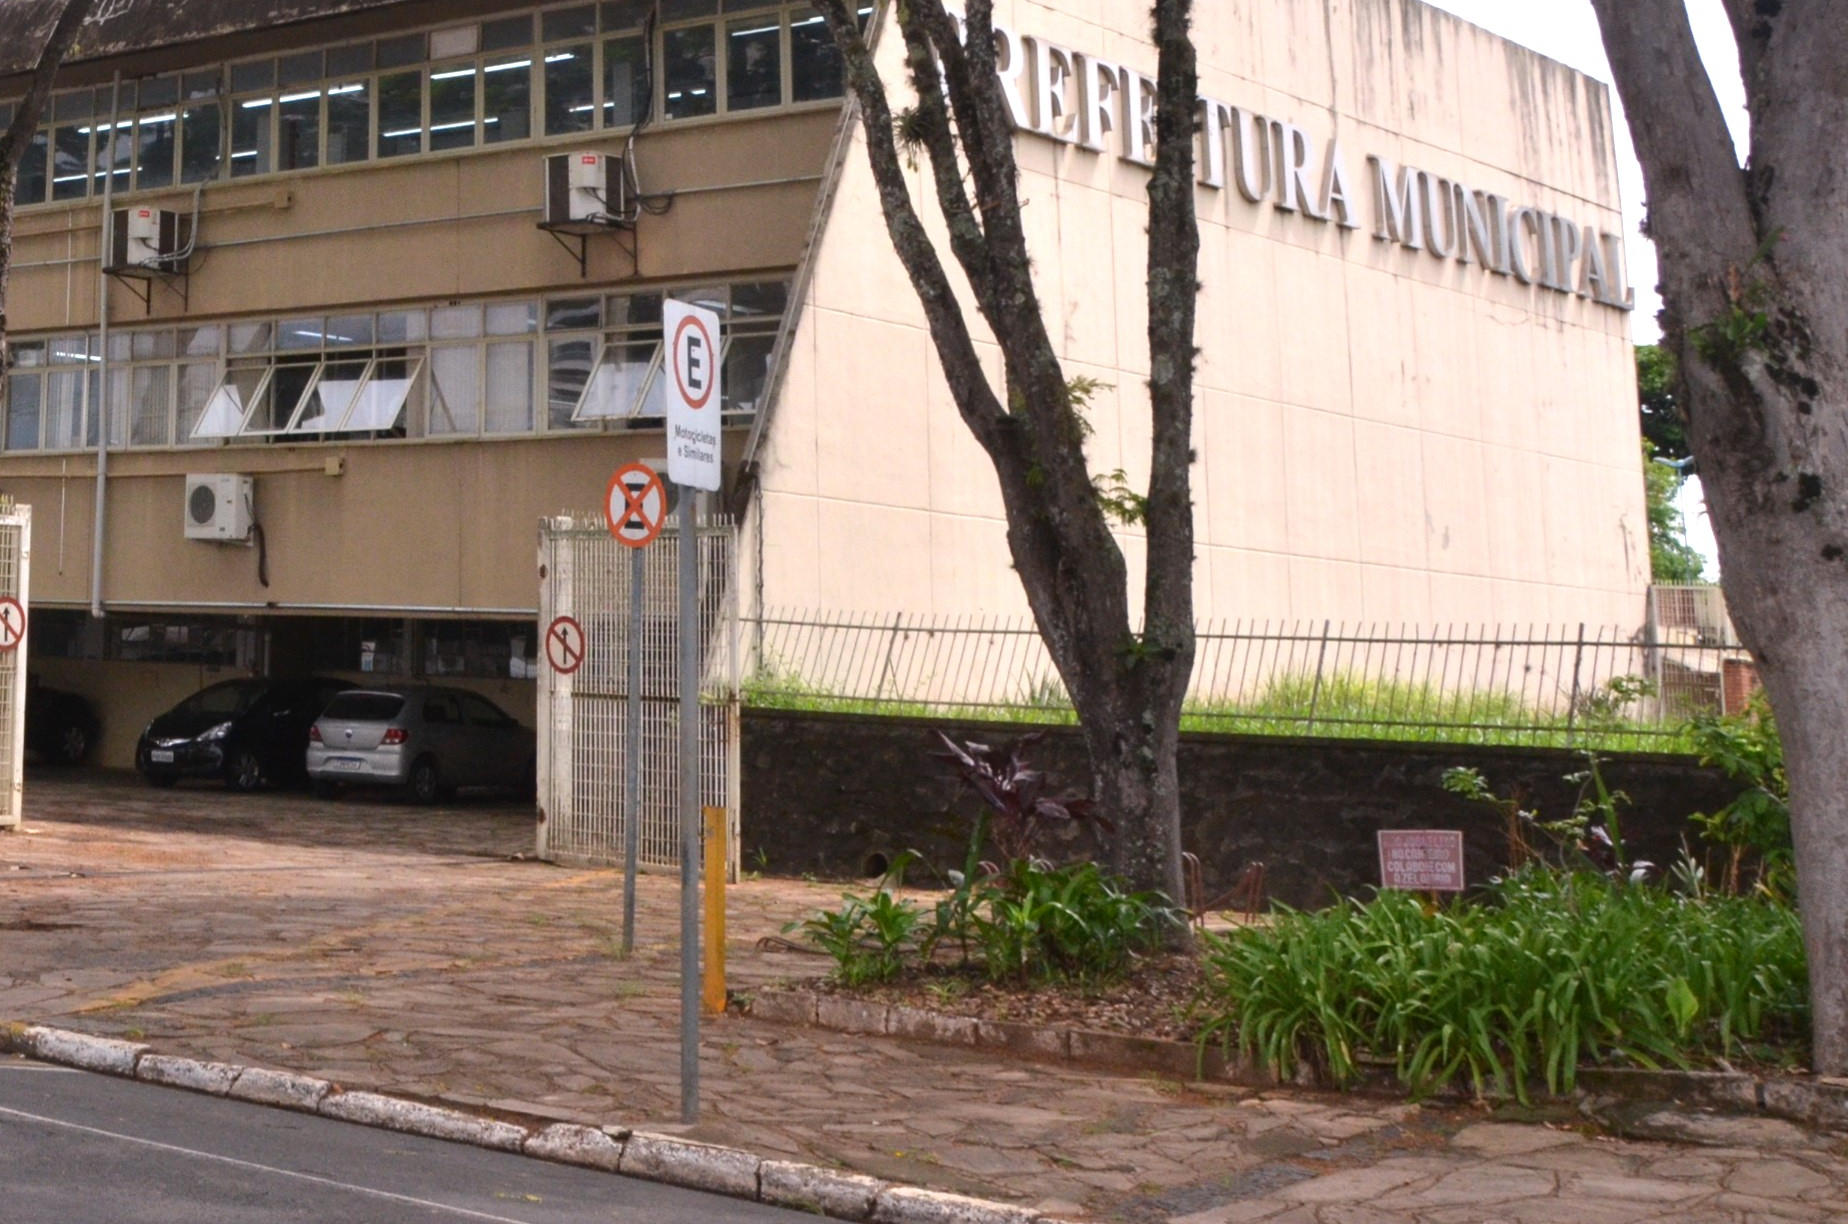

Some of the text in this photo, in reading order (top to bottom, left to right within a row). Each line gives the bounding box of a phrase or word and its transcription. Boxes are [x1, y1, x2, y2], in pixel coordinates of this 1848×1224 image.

[935, 6, 1635, 311] REFETURA MUNICIPAL
[686, 335, 702, 390] E
[674, 423, 717, 446] Motocicletas
[684, 445, 714, 463] Similares
